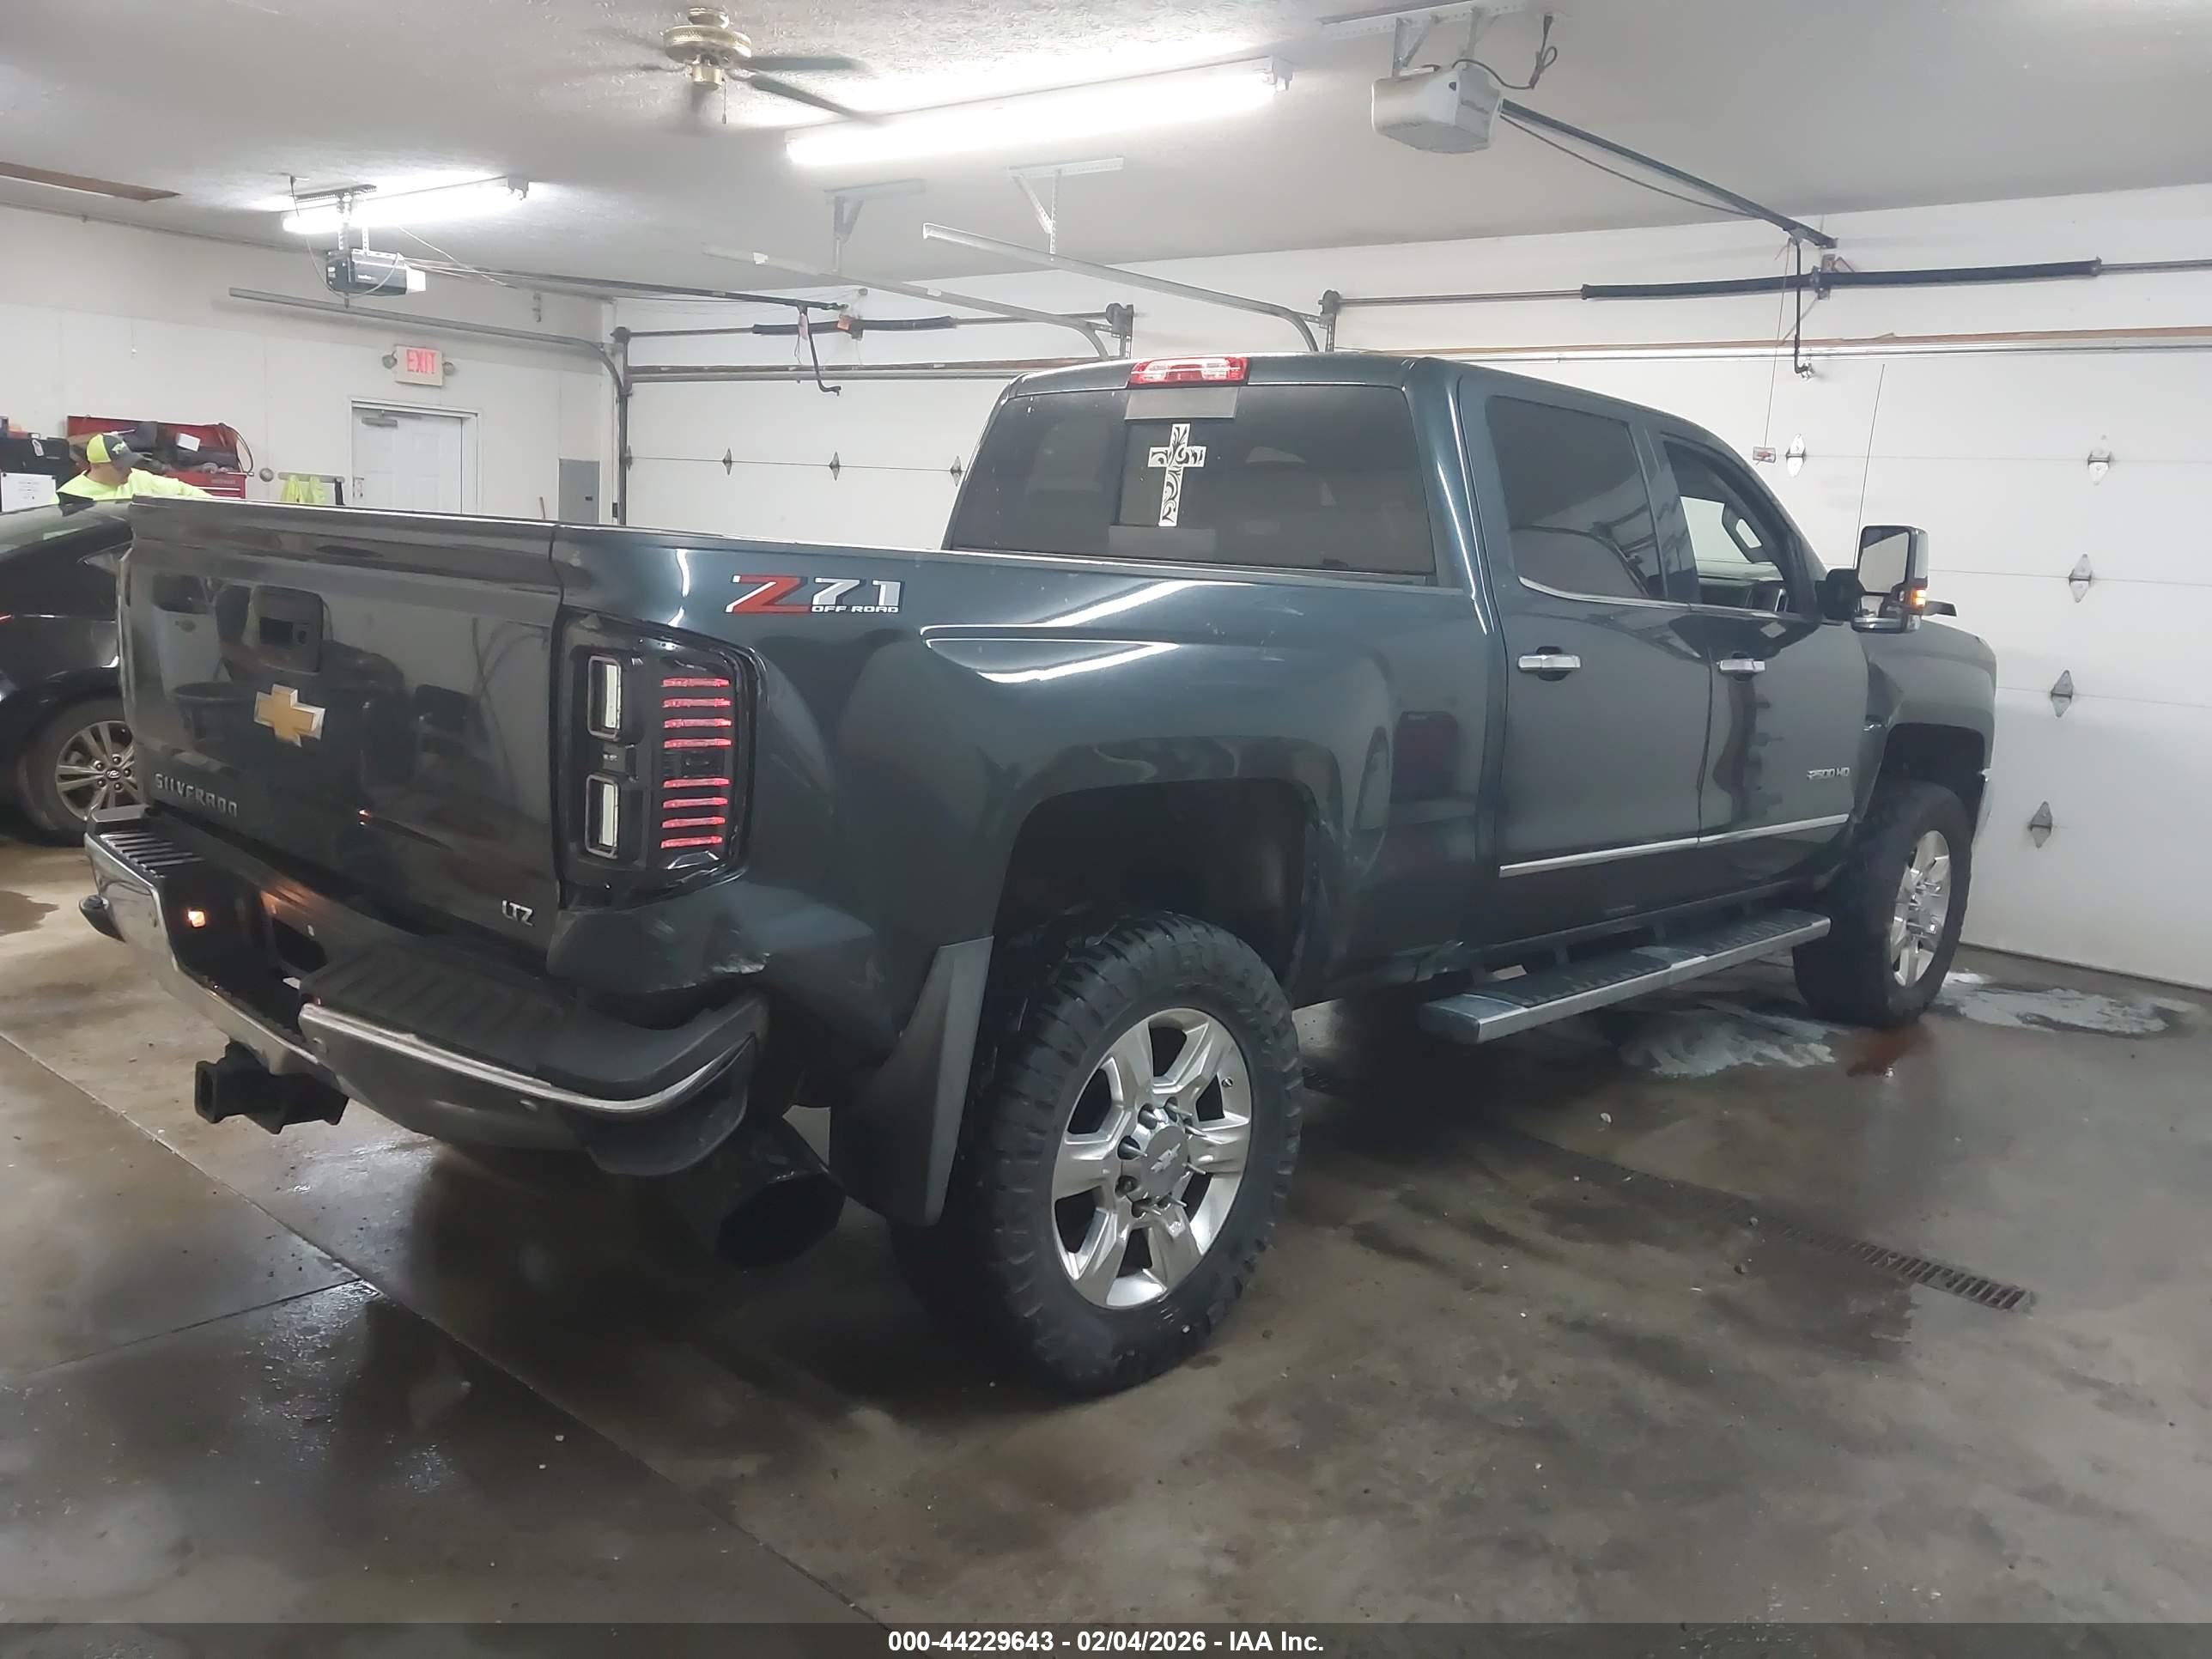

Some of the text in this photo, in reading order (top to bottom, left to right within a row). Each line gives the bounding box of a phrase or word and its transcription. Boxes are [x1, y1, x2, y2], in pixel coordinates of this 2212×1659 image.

[406, 349, 436, 374] EXIT
[725, 574, 904, 613] Z71
[811, 605, 900, 613] OFF ROAD
[155, 773, 237, 817] SILVERADO
[501, 899, 533, 927] LTZ
